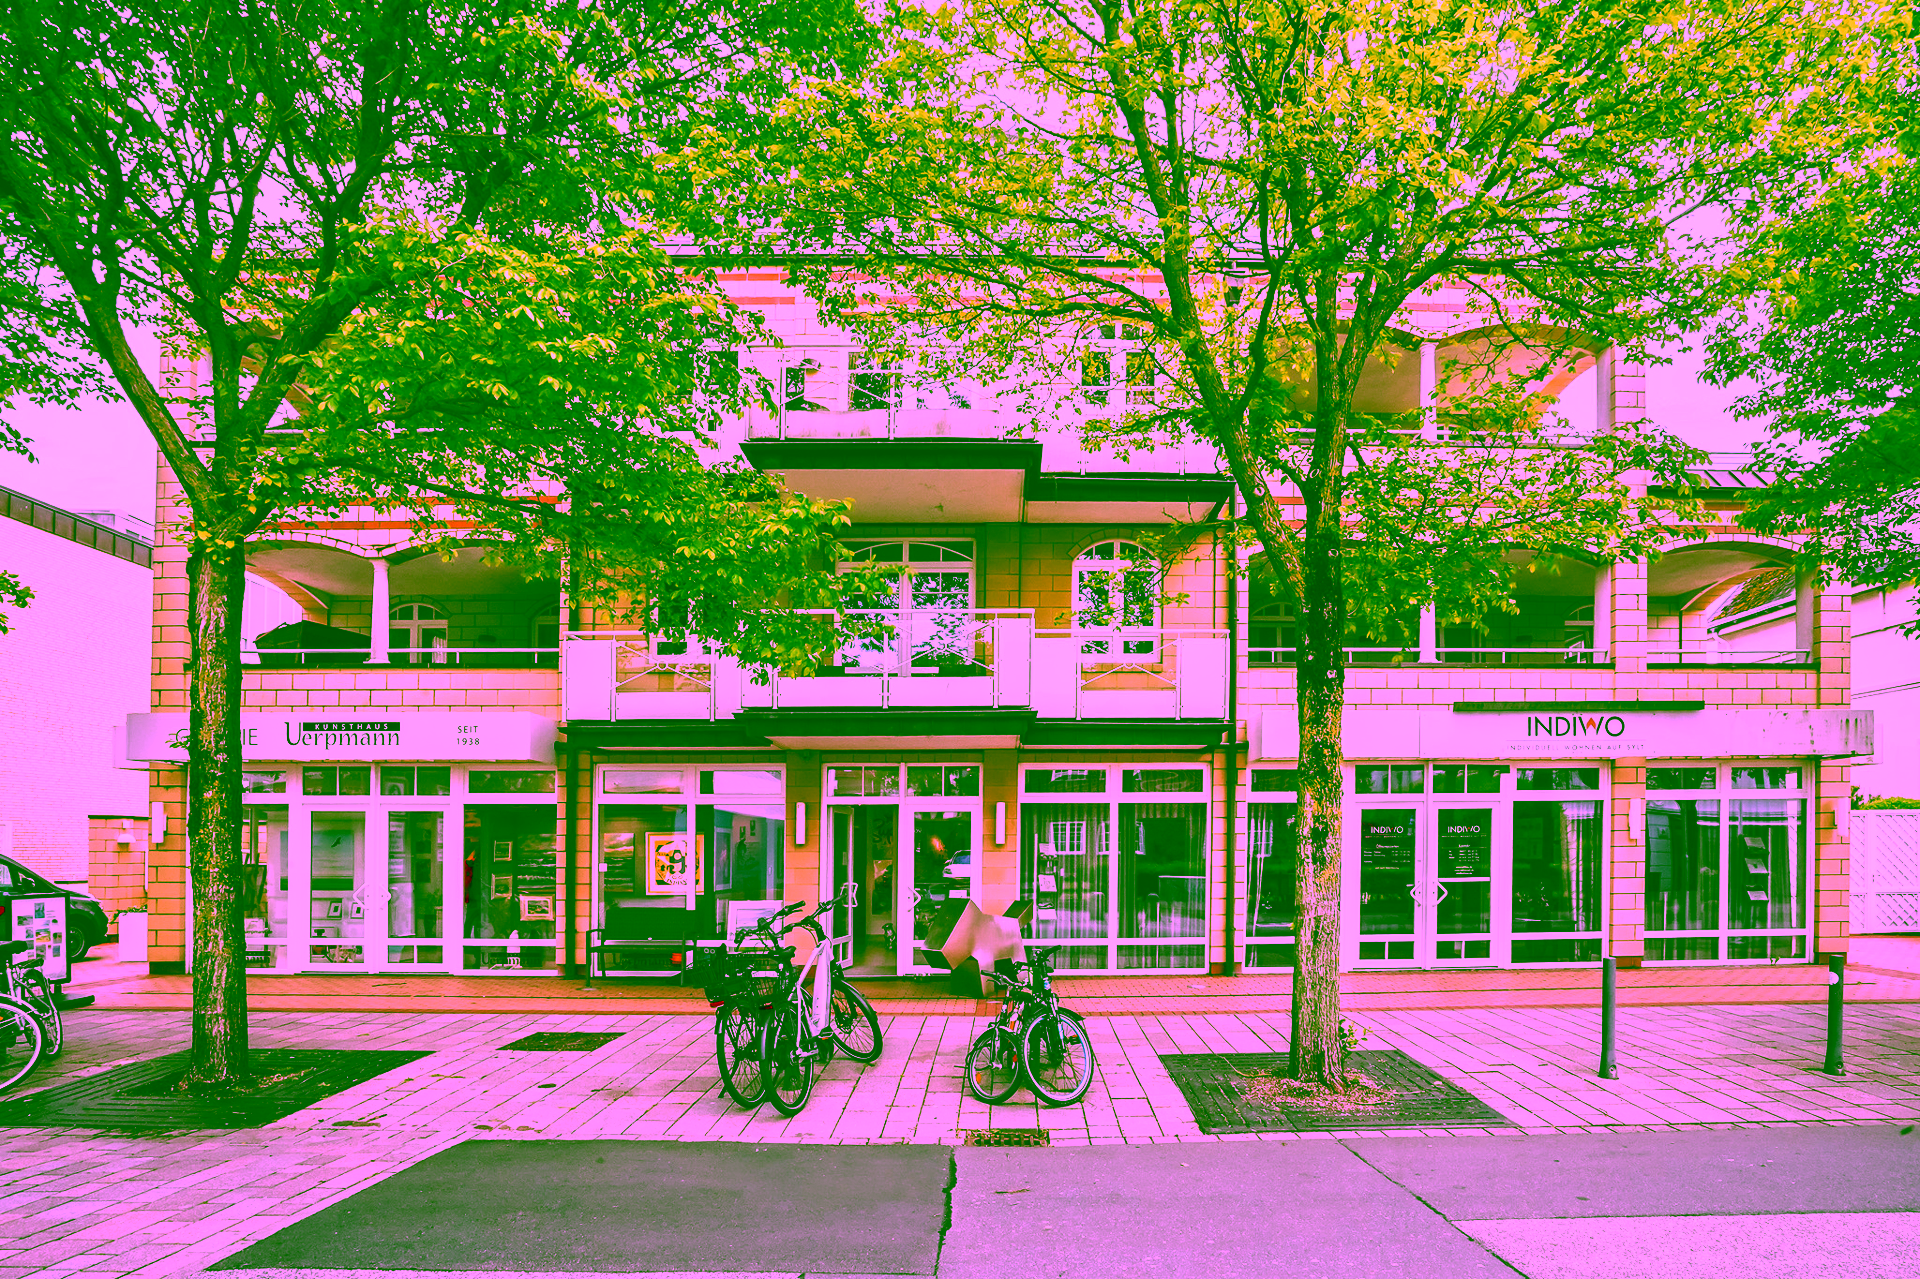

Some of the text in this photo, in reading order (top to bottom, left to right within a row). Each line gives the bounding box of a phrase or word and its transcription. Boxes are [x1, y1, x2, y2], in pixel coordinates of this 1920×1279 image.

[314, 723, 389, 731] KUNSTHAUS
[457, 725, 479, 734] SEIT
[1527, 716, 1626, 737] INDIWO
[284, 722, 400, 751] Uerpmann
[456, 737, 480, 746] 1938
[1370, 825, 1404, 834] INDIWO
[1447, 825, 1481, 834] INDIWO
